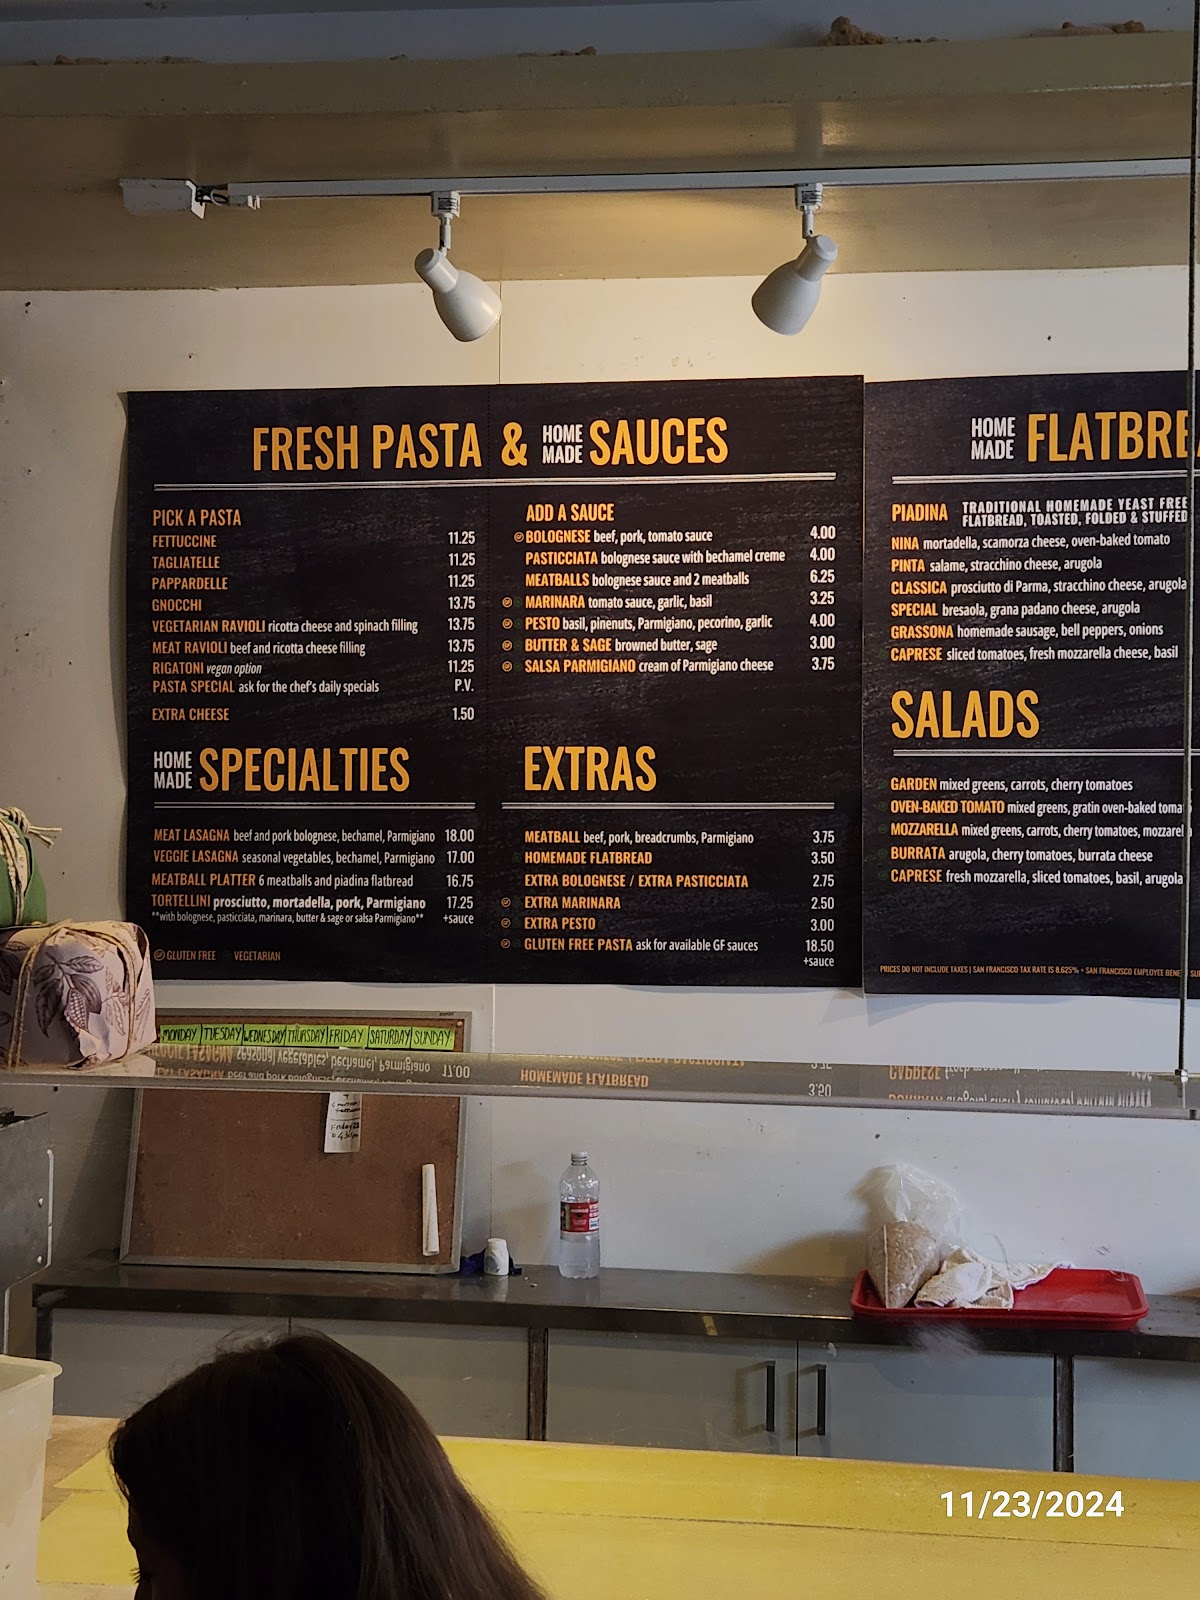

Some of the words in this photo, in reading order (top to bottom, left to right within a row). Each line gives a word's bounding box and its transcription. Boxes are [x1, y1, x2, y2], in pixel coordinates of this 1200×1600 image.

[543, 424, 583, 443] HOME
[972, 417, 1015, 437] HOME
[590, 417, 728, 465] SAUCES
[1028, 410, 1200, 462] FLATBRE
[254, 425, 358, 470] FRESH
[373, 423, 482, 468] PASTA
[502, 422, 527, 466] &
[542, 445, 582, 464] MADE
[971, 440, 1014, 460] MADE
[526, 504, 554, 522] ADD
[558, 504, 566, 521] A
[571, 504, 614, 521] SAUCE
[892, 504, 948, 521] PIADINA
[963, 502, 1040, 514] TRADITIONAL
[1047, 500, 1113, 512] HOMEMADE
[1118, 498, 1154, 510] YEAST
[1159, 497, 1188, 510] FREE
[154, 510, 183, 526] PICK
[188, 510, 196, 526] A
[201, 509, 241, 526] PASTA
[963, 514, 1027, 527] FLATBREAD,
[1031, 513, 1082, 526] TOASTED,
[1086, 512, 1126, 524] FOLDED
[1131, 512, 1137, 523] &
[1142, 511, 1187, 523] STUFFED
[153, 535, 216, 547] FETTUCCINE
[448, 531, 475, 544] 11.25
[526, 530, 590, 543] BOLOGNESE
[594, 530, 618, 544] beef,
[620, 530, 646, 546] pork,
[648, 530, 683, 542] tomato
[685, 532, 712, 542] sauce
[810, 526, 836, 539] 4.00
[892, 537, 919, 550] NINA
[923, 536, 980, 550] mortadella,
[983, 538, 1029, 548] scamorza
[1032, 535, 1068, 548] cheese,
[1072, 533, 1130, 546] oven-baked
[1134, 534, 1170, 545] tomato
[152, 556, 220, 568] TAGLIATELLE
[449, 553, 475, 566] 11.25
[526, 552, 598, 565] PASTICCIATA
[601, 551, 650, 568] bolognese
[652, 554, 680, 564] sauce
[682, 550, 703, 563] with
[706, 549, 752, 563] bechamel
[755, 552, 785, 562] creme
[810, 547, 835, 561] 4.00
[891, 559, 925, 572] PINTA
[930, 559, 968, 573] salame,
[970, 558, 1022, 571] stracchino
[1024, 558, 1061, 571] cheese,
[1064, 556, 1102, 572] arugola
[152, 577, 228, 590] PAPPARDELLE
[448, 574, 474, 587] 11.25
[152, 599, 201, 611] GNOCCHI
[448, 596, 475, 609] 13.75
[526, 595, 585, 608] MARINARA
[588, 597, 623, 610] tomato
[625, 598, 655, 610] sauce,
[657, 595, 687, 611] garlic,
[690, 594, 712, 607] basil
[810, 591, 834, 605] 3.25
[152, 620, 218, 632] VEGETARIAN
[222, 620, 265, 632] RAVIOLI
[268, 620, 299, 632] ricotta
[301, 620, 332, 632] cheese
[335, 619, 352, 632] and
[354, 619, 389, 635] spinach
[391, 618, 418, 634] filling
[448, 617, 474, 630] 13.75
[525, 638, 567, 652] BUTTER
[571, 638, 579, 651] &
[583, 638, 612, 652] SAGE
[615, 638, 658, 651] browned
[661, 638, 693, 652] butter,
[696, 640, 717, 654] sage
[810, 636, 835, 649] 3.00
[153, 662, 204, 674] RIGATONI
[207, 665, 232, 677] vegan
[234, 662, 262, 677] option
[448, 660, 474, 672] 11.25
[153, 680, 187, 692] PASTA
[191, 680, 235, 692] SPECIAL
[239, 680, 254, 692] ask
[256, 680, 270, 692] for
[272, 680, 287, 692] the
[290, 680, 317, 692] chef's
[319, 680, 341, 696] daily
[343, 680, 379, 696] specials
[455, 679, 474, 691] P.V.
[152, 708, 185, 720] EXTRA
[189, 708, 229, 720] CHEESE
[452, 707, 474, 720] 1.50
[891, 690, 1039, 738] SALADS
[154, 751, 192, 768] HOME
[200, 747, 409, 792] SPECIALTIES
[525, 746, 656, 791] EXTRAS
[154, 772, 192, 788] MADE
[891, 777, 937, 790] GARDEN
[940, 778, 970, 790] mixed
[972, 781, 1008, 794] greens,
[1011, 780, 1048, 792] carrots,
[1051, 778, 1083, 794] cherry
[1086, 780, 1133, 790] tomatoes
[525, 831, 580, 843] MEATBALL
[584, 831, 606, 844] beef,
[609, 831, 632, 846] pork,
[635, 831, 698, 845] breadcrumbs,
[702, 832, 754, 846] Parmigiano
[813, 830, 834, 843] 3.75
[154, 850, 189, 862] VEGGIE
[192, 850, 238, 862] LASAGNA
[242, 851, 280, 863] seasonal
[283, 851, 333, 866] vegetables,
[336, 851, 382, 865] bechamel,
[384, 852, 435, 867] Parmigiano
[447, 851, 474, 863] 17.00
[525, 851, 586, 864] HOMEMADE
[590, 852, 652, 864] FLATBREAD
[811, 852, 834, 864] 3.50
[891, 846, 946, 860] BURRATA
[949, 848, 989, 863] arugola,
[992, 848, 1024, 864] cherry
[1026, 850, 1075, 862] tomatoes,
[1078, 848, 1116, 861] burrata
[1118, 849, 1153, 862] cheese
[152, 894, 210, 906] TORTELLINI
[214, 896, 270, 910] prosciutto,
[273, 896, 333, 910] mortadella,
[336, 896, 364, 912] pork,
[367, 896, 426, 912] Parmigiano
[447, 896, 473, 909] 17.25
[525, 896, 558, 908] EXTRA
[562, 896, 620, 909] MARINARA
[811, 897, 834, 909] 2.50
[444, 914, 474, 924] +sauce
[525, 917, 558, 929] EXTRA
[562, 918, 595, 930] PESTO
[810, 919, 834, 931] 3.00
[167, 950, 196, 960] GLUTEN
[198, 951, 216, 960] FREE
[234, 951, 280, 960] VEGETARIAN
[162, 1028, 197, 1041] MONDAY
[204, 1027, 242, 1041] TUESDAY
[244, 1028, 286, 1043] WEDNESDAY
[288, 1026, 325, 1045] THURSDAY
[329, 1029, 363, 1043] FRIDAY
[370, 1029, 410, 1048] SATURDAY
[414, 1030, 450, 1047] SUNDAY
